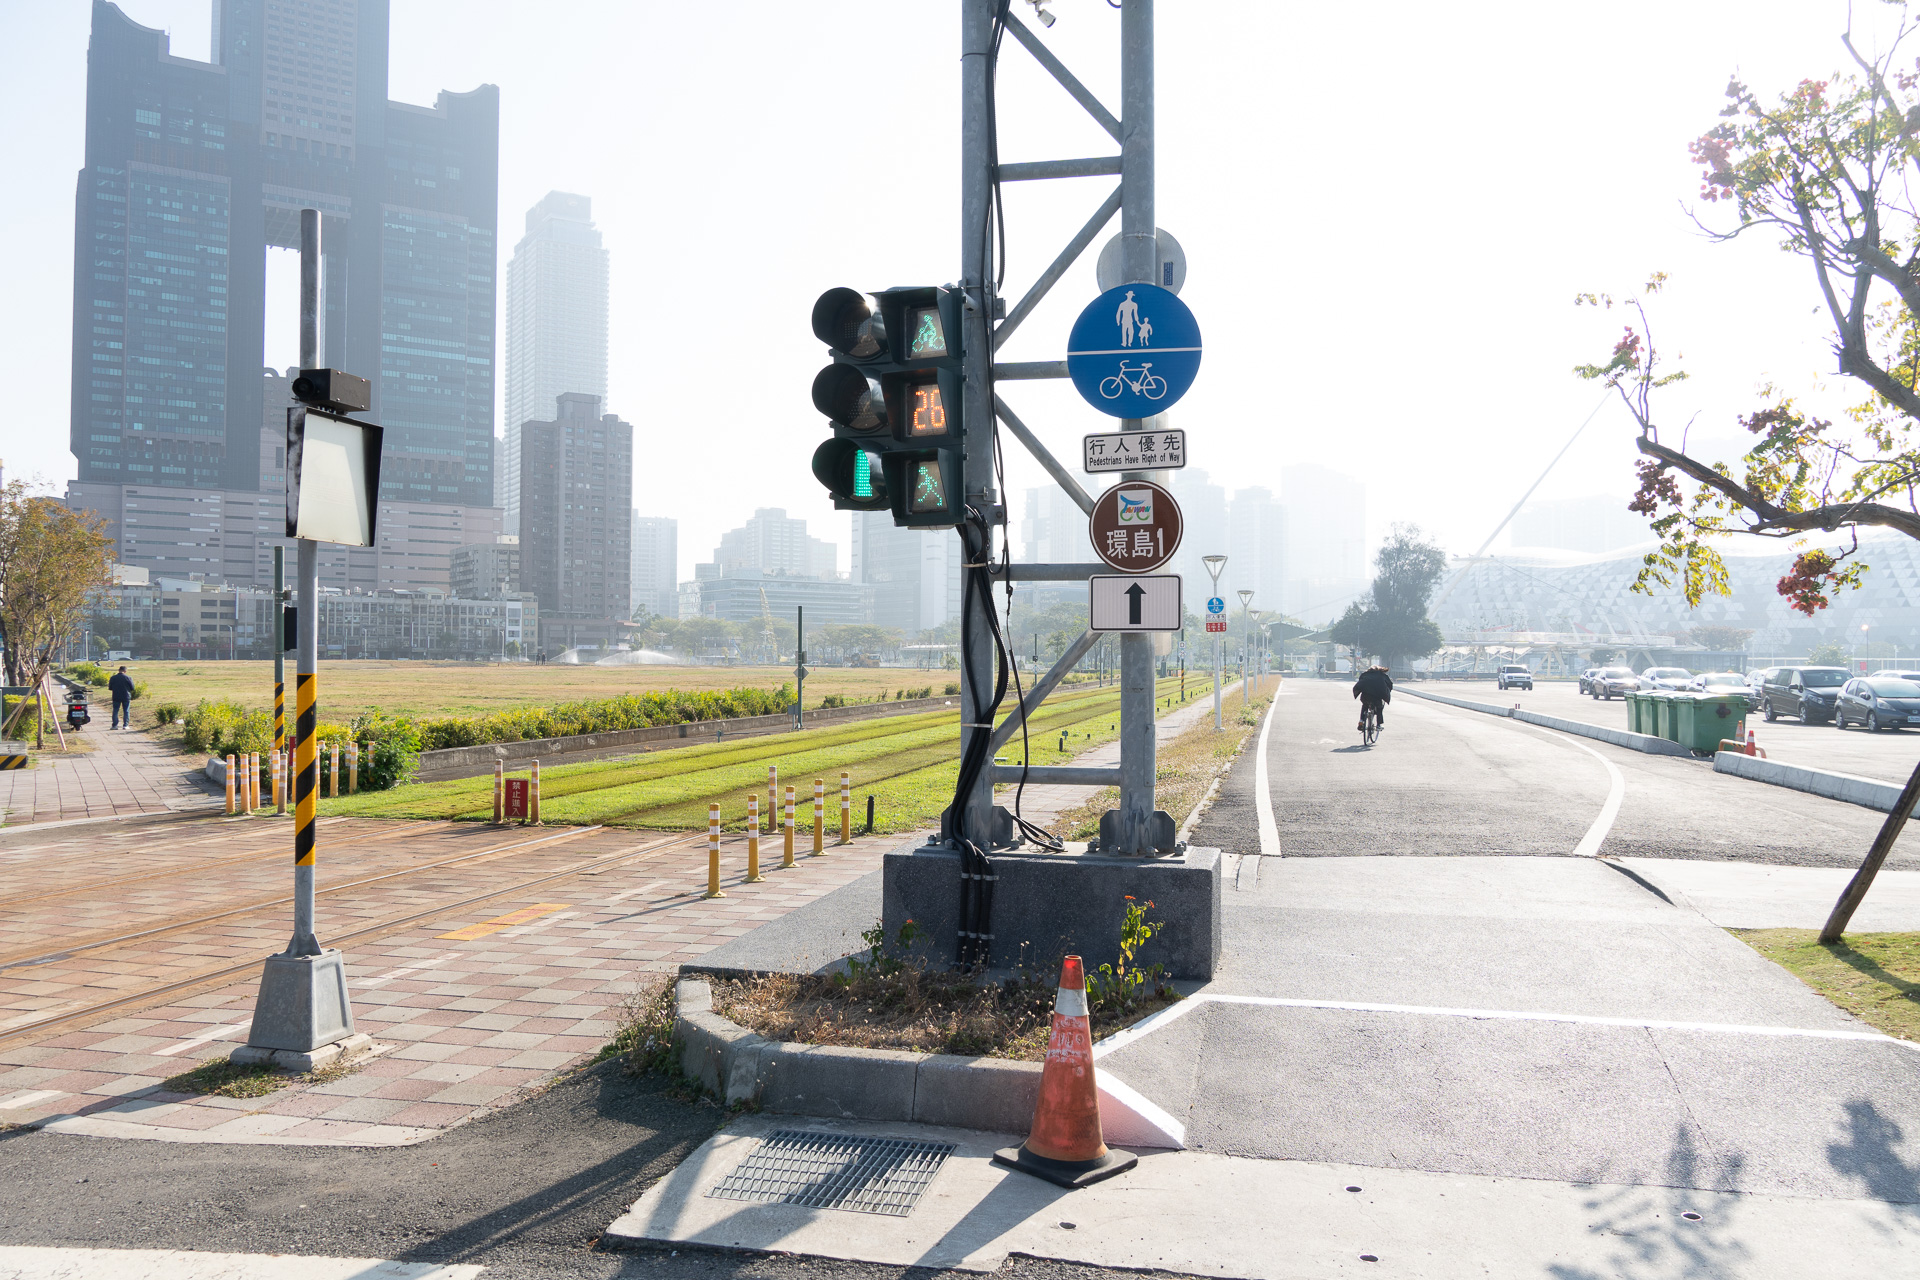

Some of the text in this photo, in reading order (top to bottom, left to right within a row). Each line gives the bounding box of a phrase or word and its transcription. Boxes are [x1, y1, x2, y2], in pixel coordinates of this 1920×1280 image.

[914, 389, 944, 428] 26
[1089, 434, 1180, 455] 行人優先
[1089, 452, 1180, 466] Pedestrians Have Right of Way
[1119, 494, 1151, 513] TAIWAN
[1106, 527, 1164, 559] 環島1
[512, 781, 520, 815] 禁止進入
